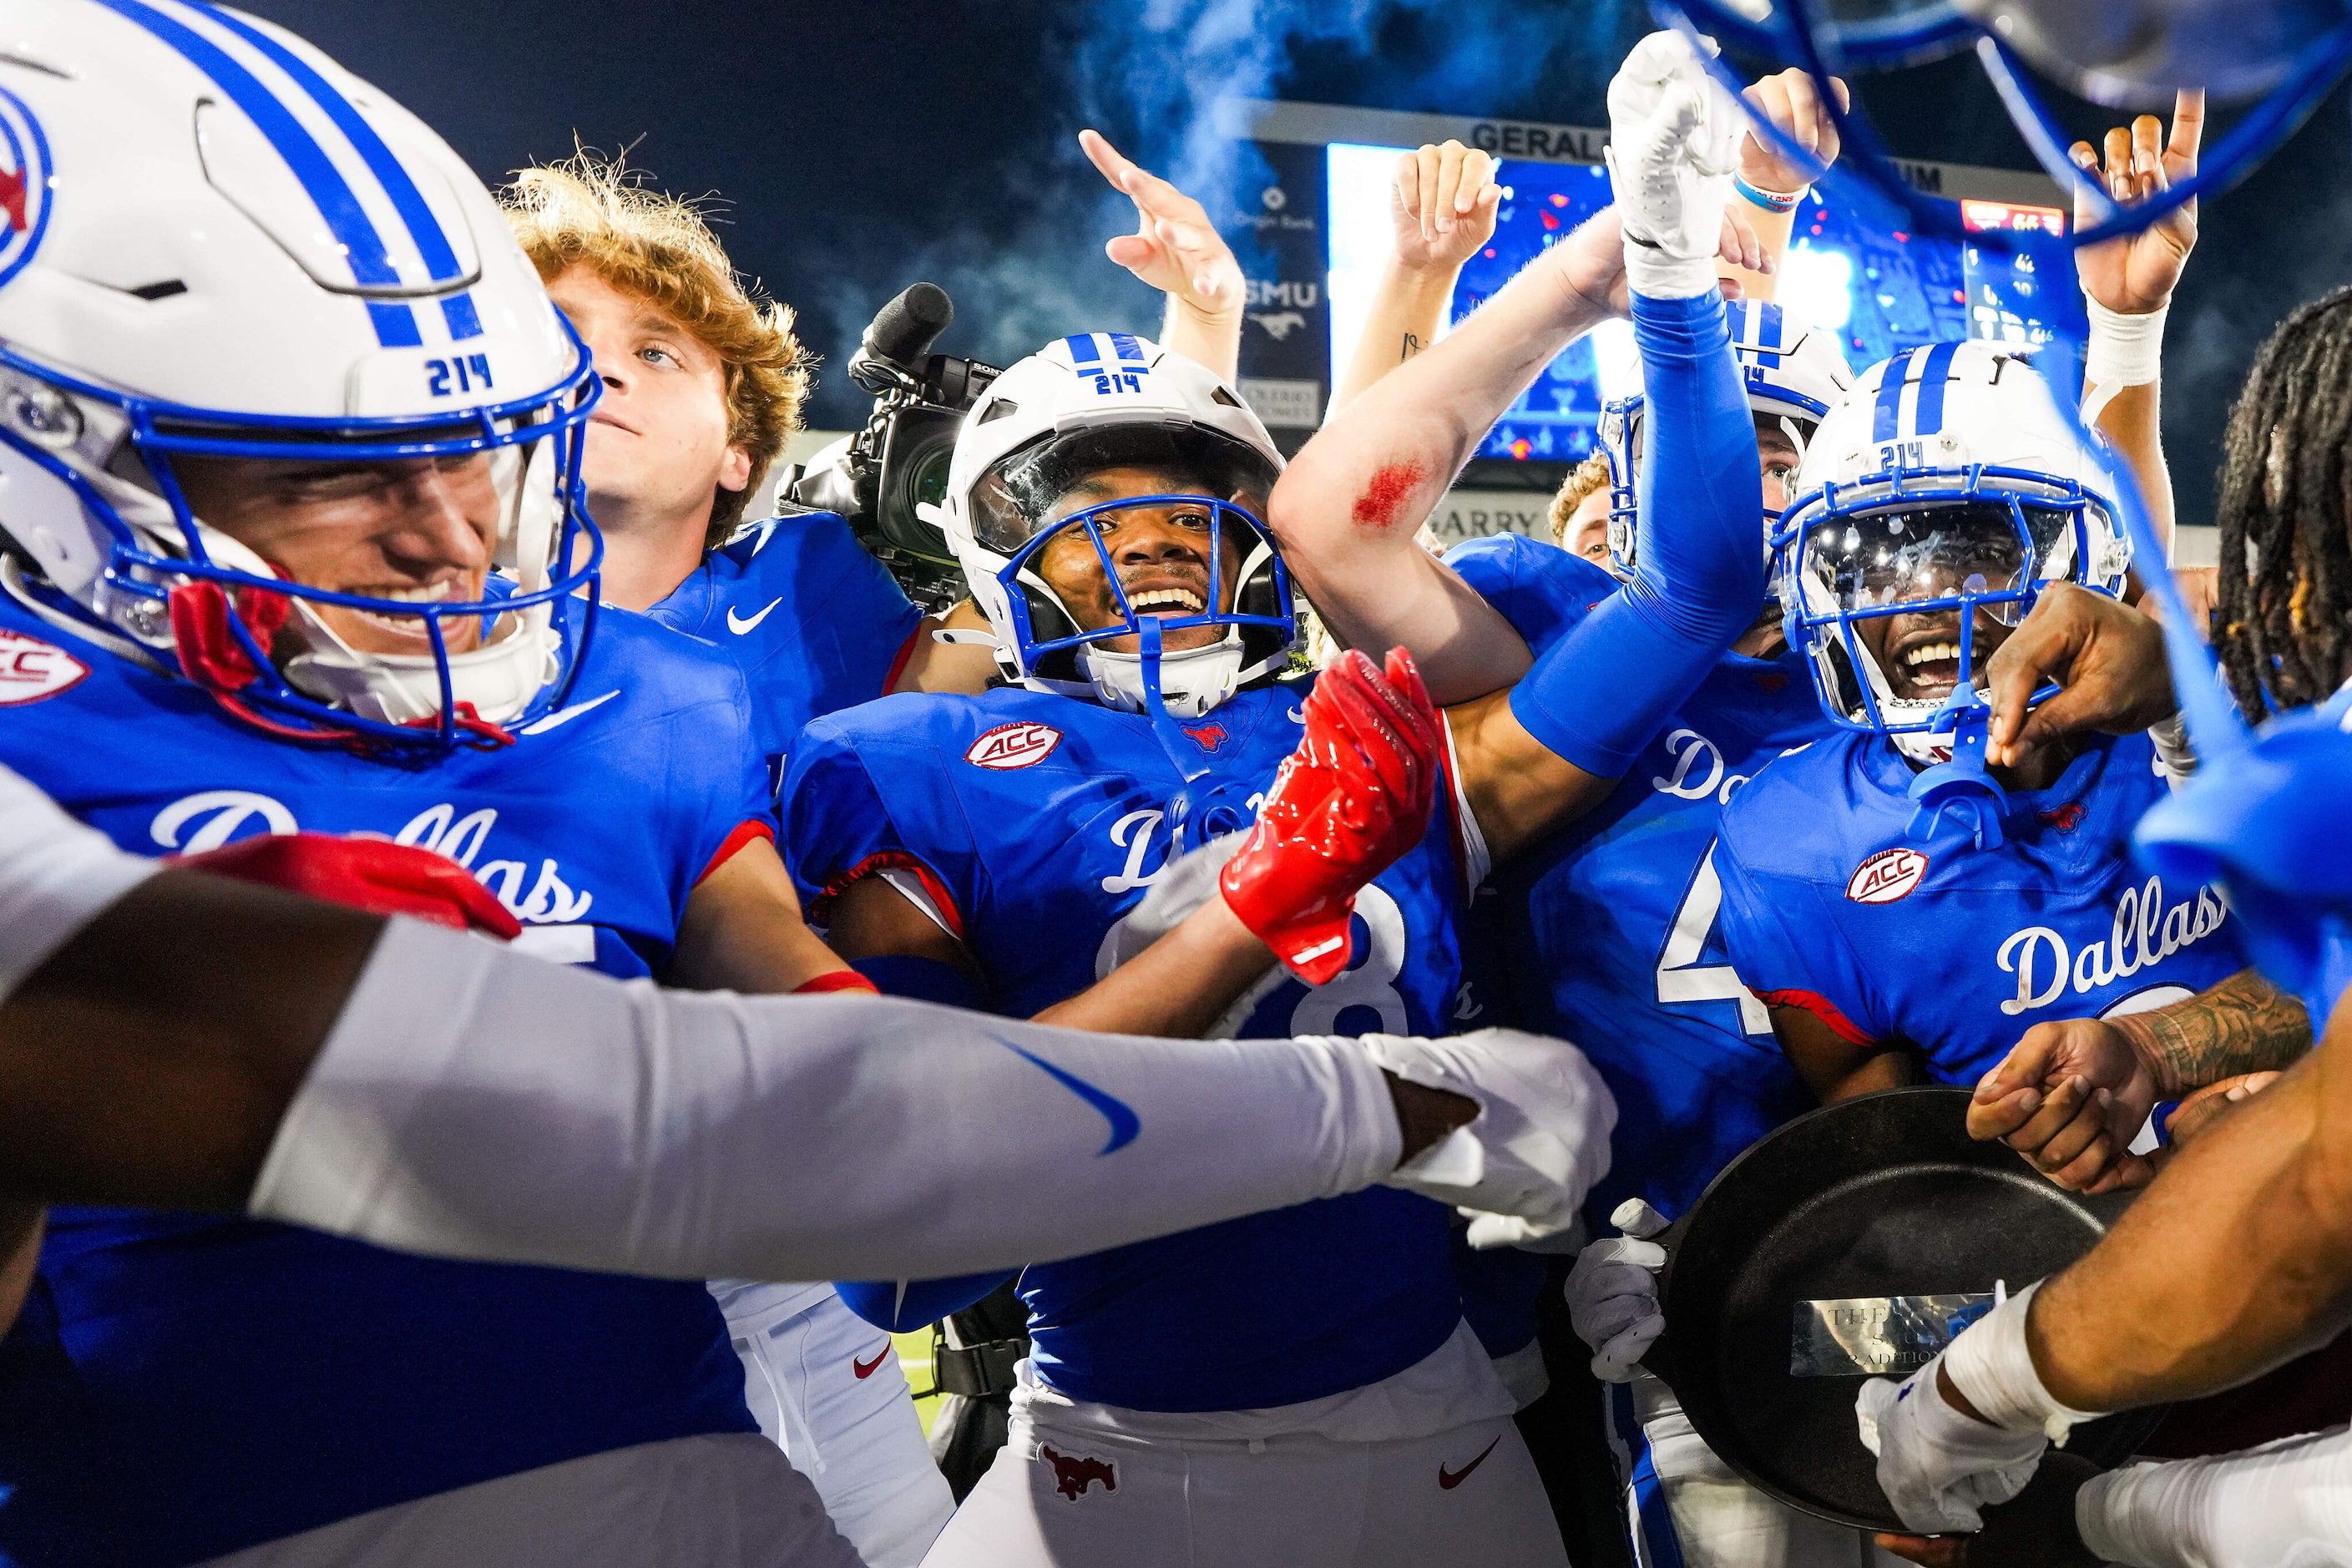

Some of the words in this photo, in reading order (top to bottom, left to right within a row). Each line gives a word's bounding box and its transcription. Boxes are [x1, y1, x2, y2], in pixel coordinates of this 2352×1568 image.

[1472, 123, 1611, 162] GERAL
[1245, 279, 1317, 308] SMU
[424, 353, 493, 397] 214
[1095, 373, 1141, 395] 214
[1743, 365, 1765, 384] 14
[1880, 441, 1925, 473] 214
[1431, 508, 1540, 538] ARRY
[980, 727, 1045, 759] ACC
[150, 790, 594, 923] Dllas
[1860, 852, 1914, 893] ACC
[1997, 875, 2226, 1015] Dallas
[1828, 1307, 1889, 1326] THE
